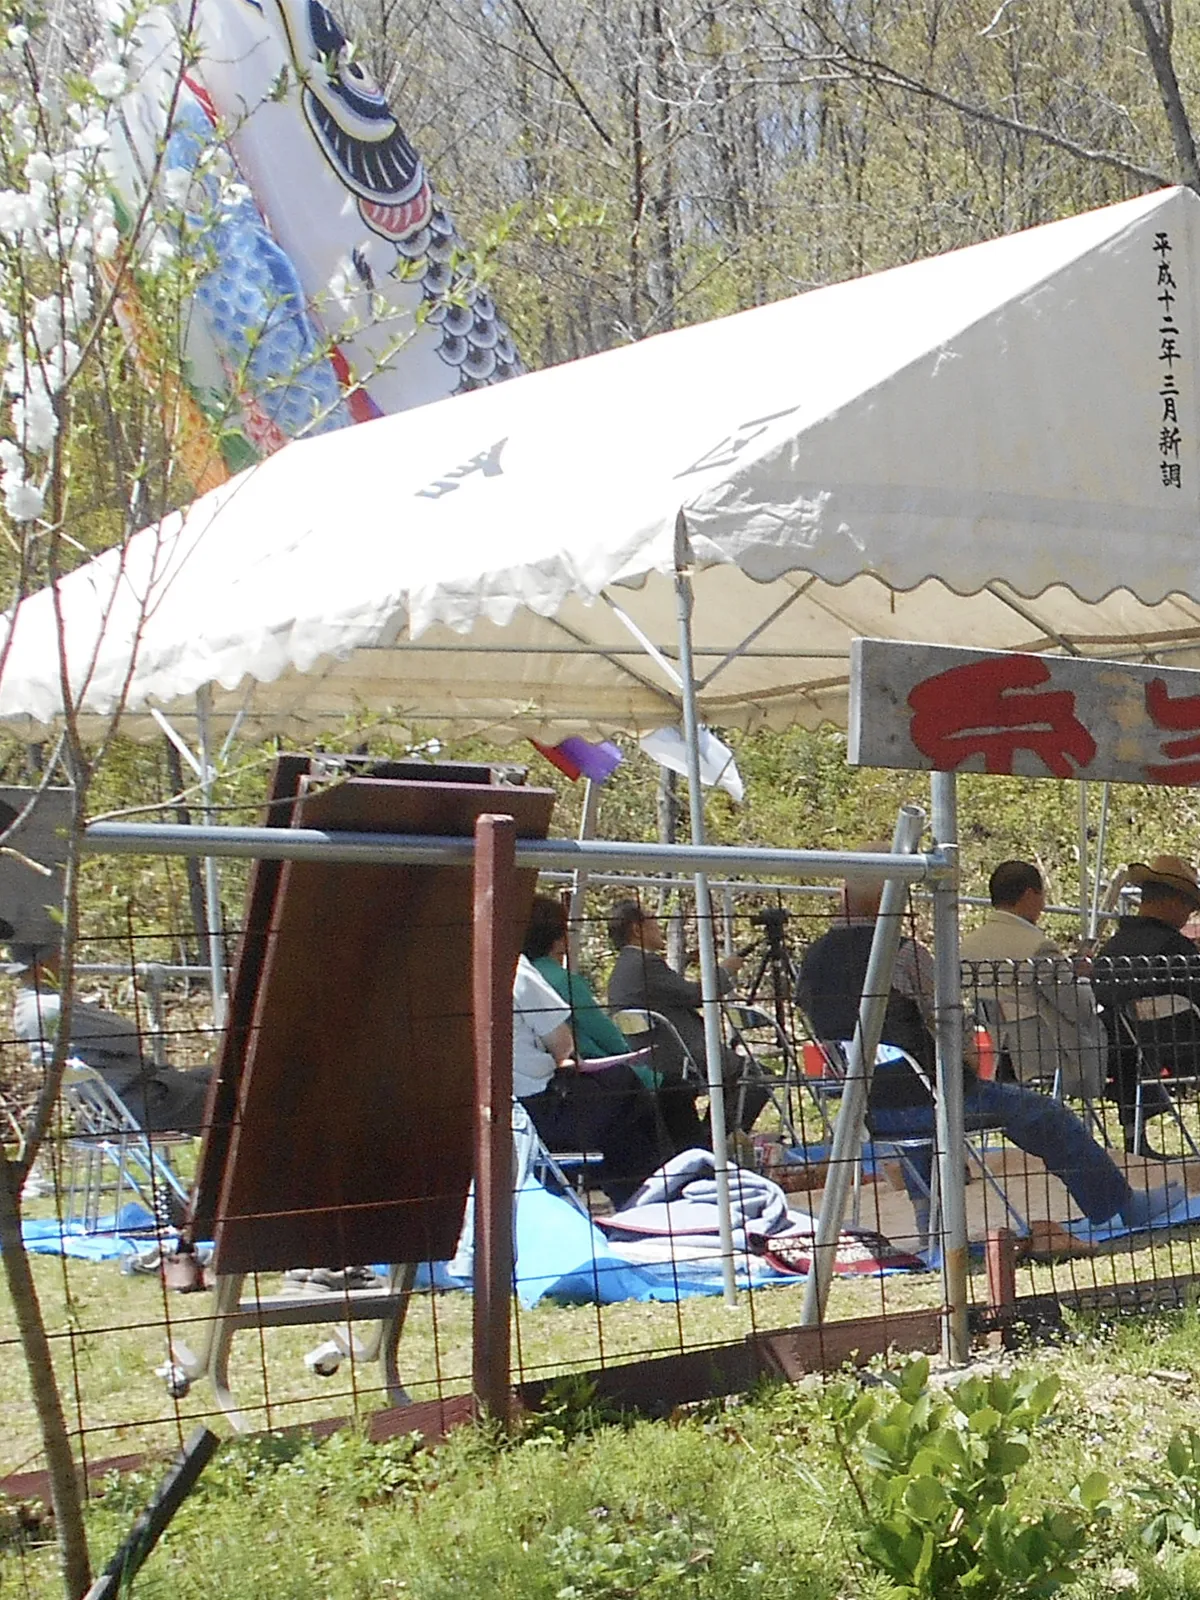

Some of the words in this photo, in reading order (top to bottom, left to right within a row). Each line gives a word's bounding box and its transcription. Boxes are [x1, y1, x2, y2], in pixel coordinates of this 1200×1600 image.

[1153, 232, 1182, 489] 平成十二年三月新調
